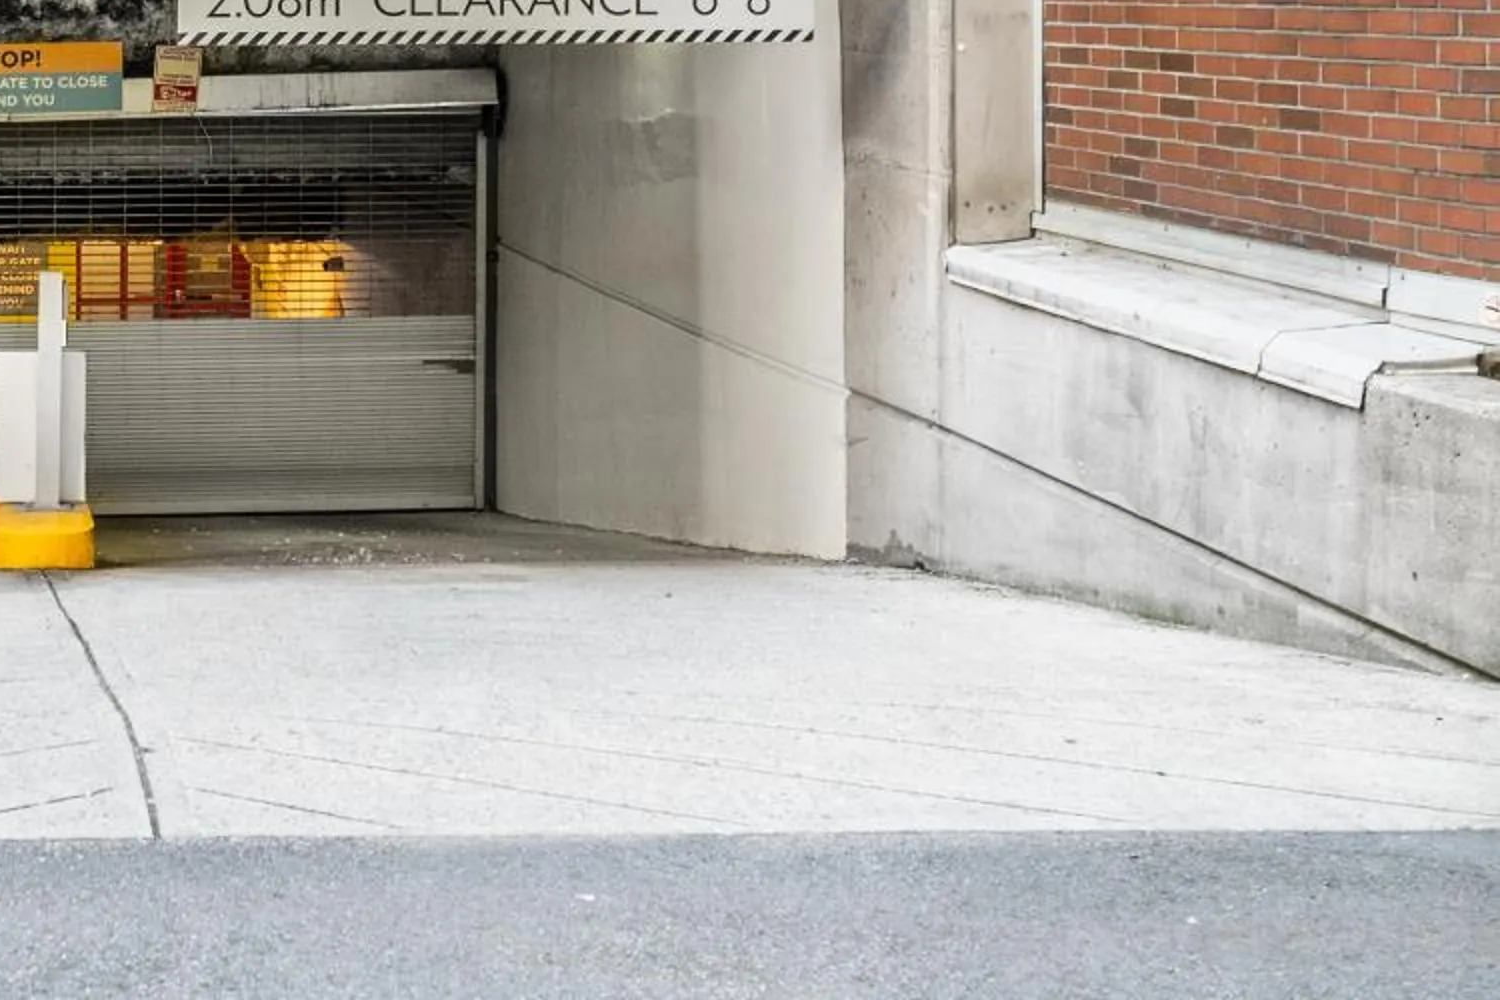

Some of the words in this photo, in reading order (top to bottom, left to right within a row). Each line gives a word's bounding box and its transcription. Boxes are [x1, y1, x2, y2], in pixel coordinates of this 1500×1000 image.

[33, 76, 54, 90] TO
[57, 74, 109, 89] CLOSE
[23, 93, 56, 107] YOU
